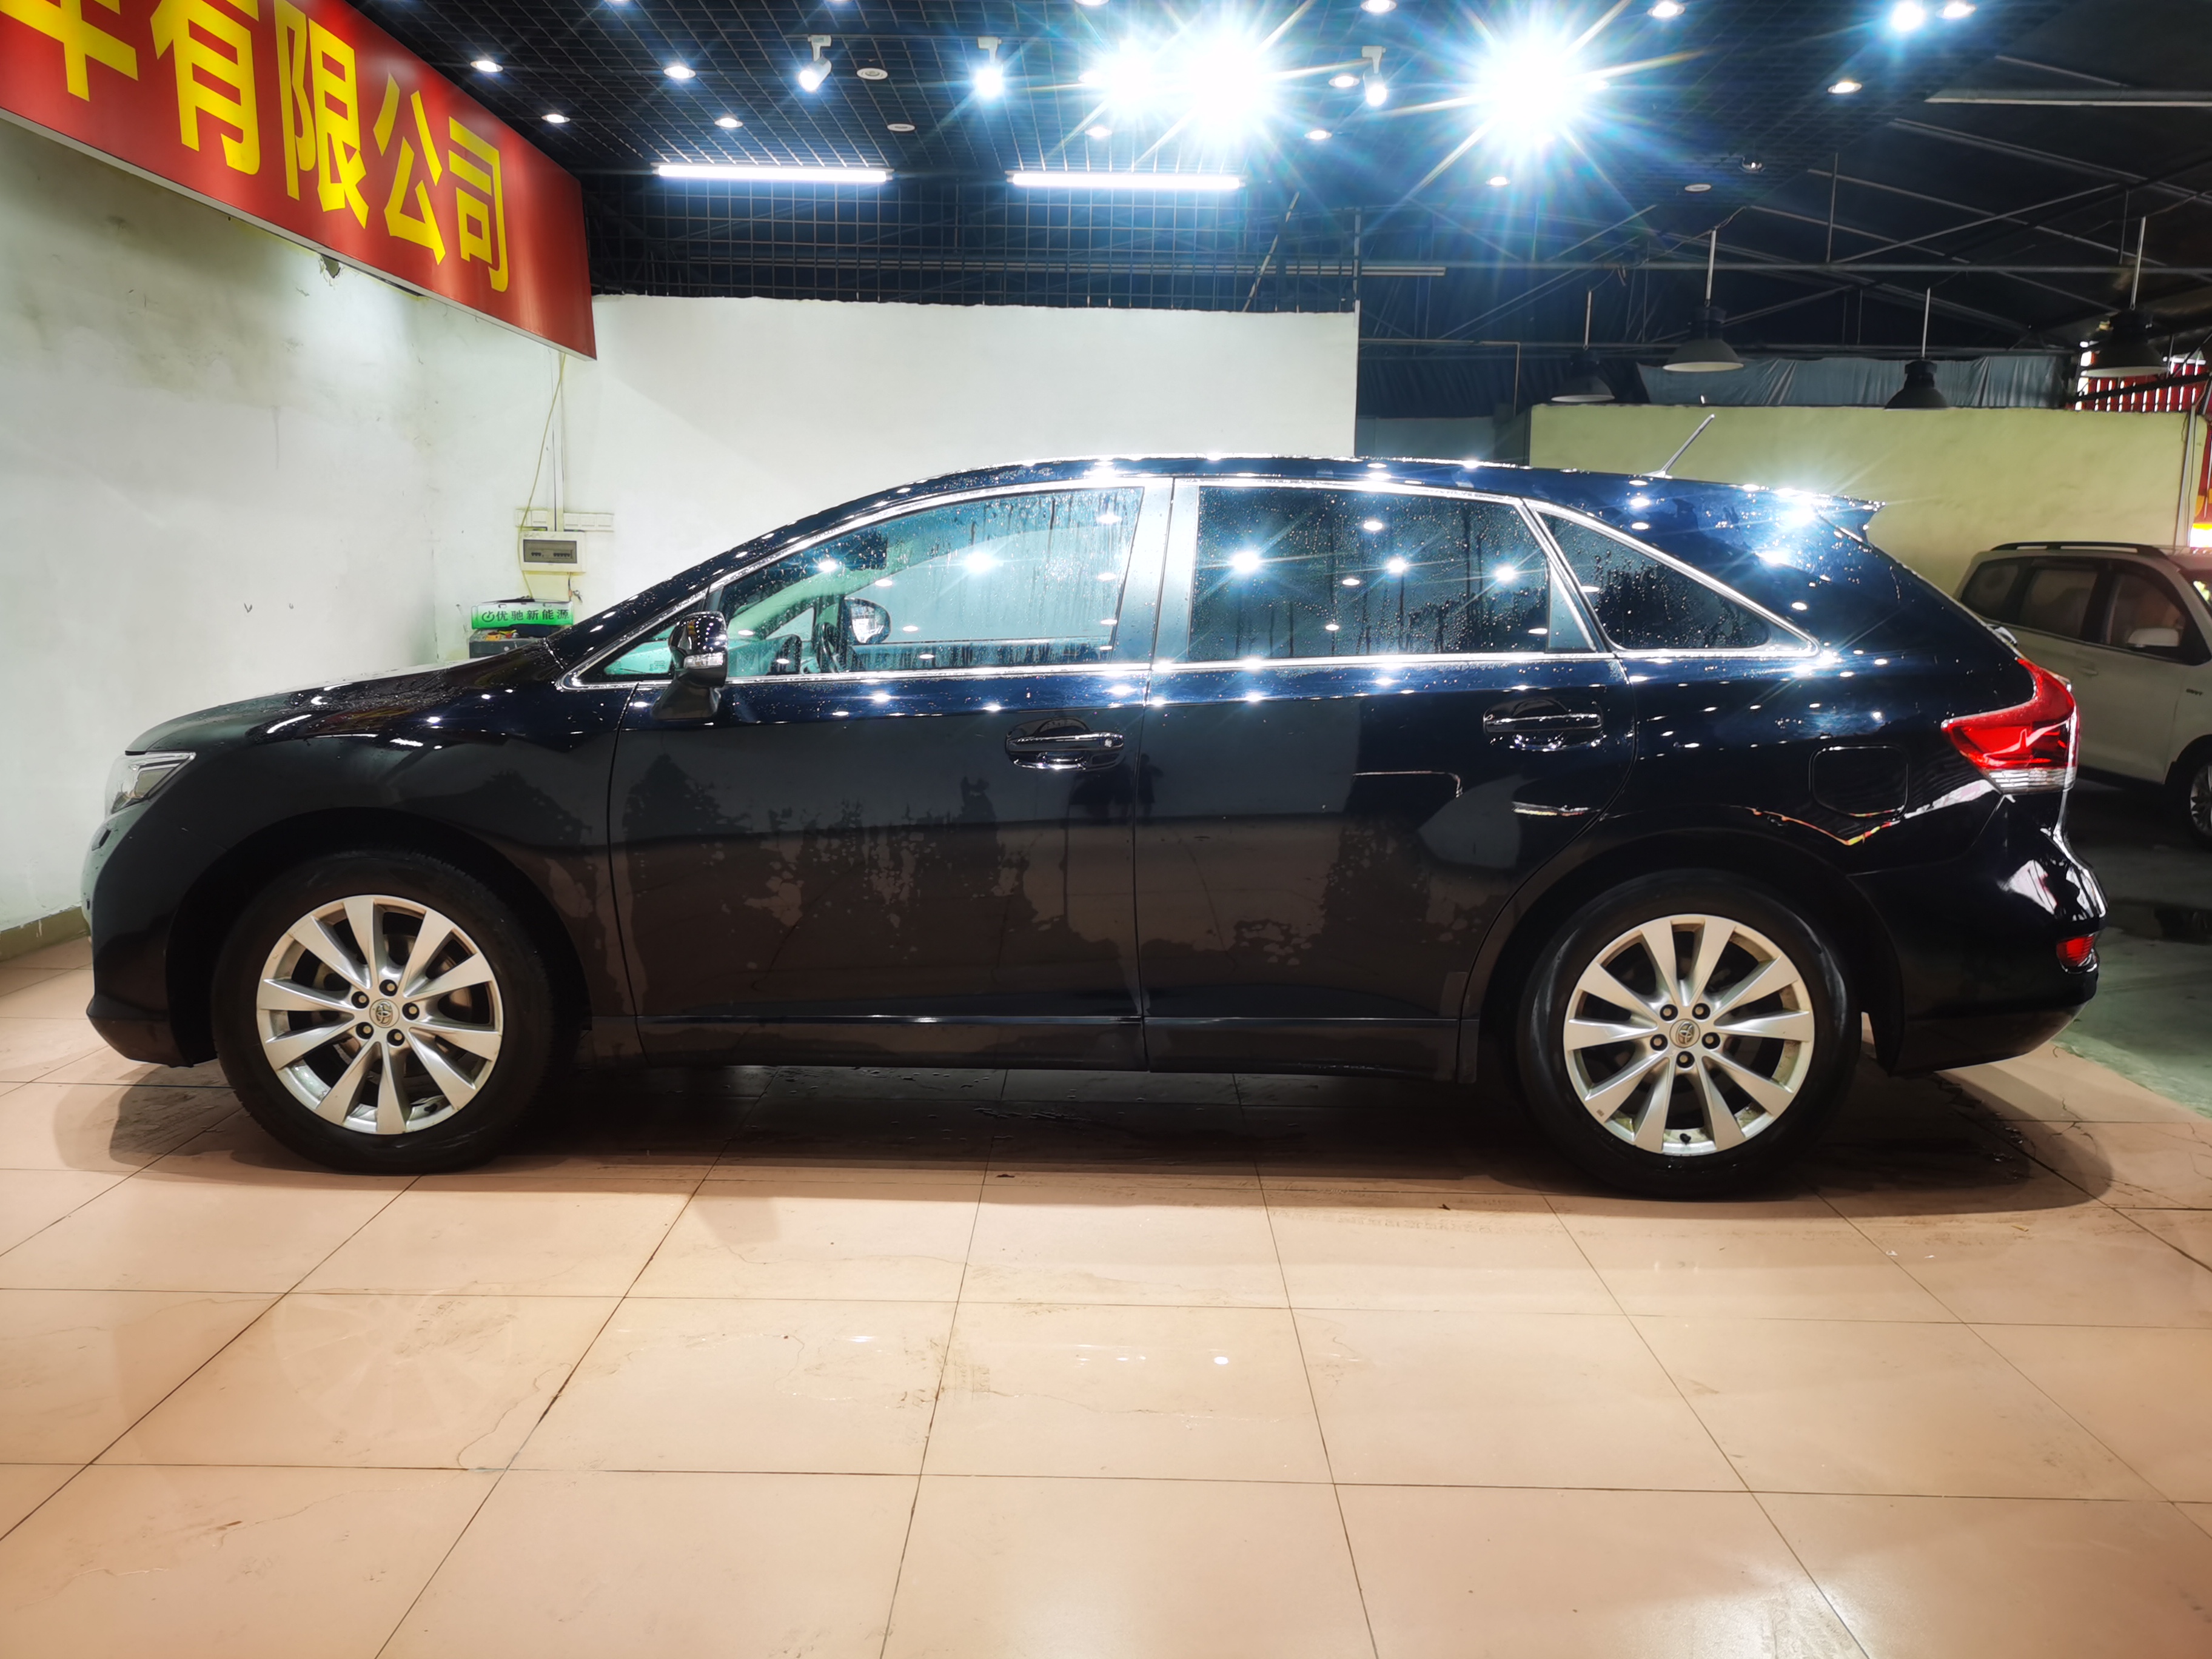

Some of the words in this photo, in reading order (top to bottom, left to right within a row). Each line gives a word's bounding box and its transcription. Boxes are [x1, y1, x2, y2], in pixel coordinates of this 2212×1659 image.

[496, 609, 569, 622] 优驰新能源
